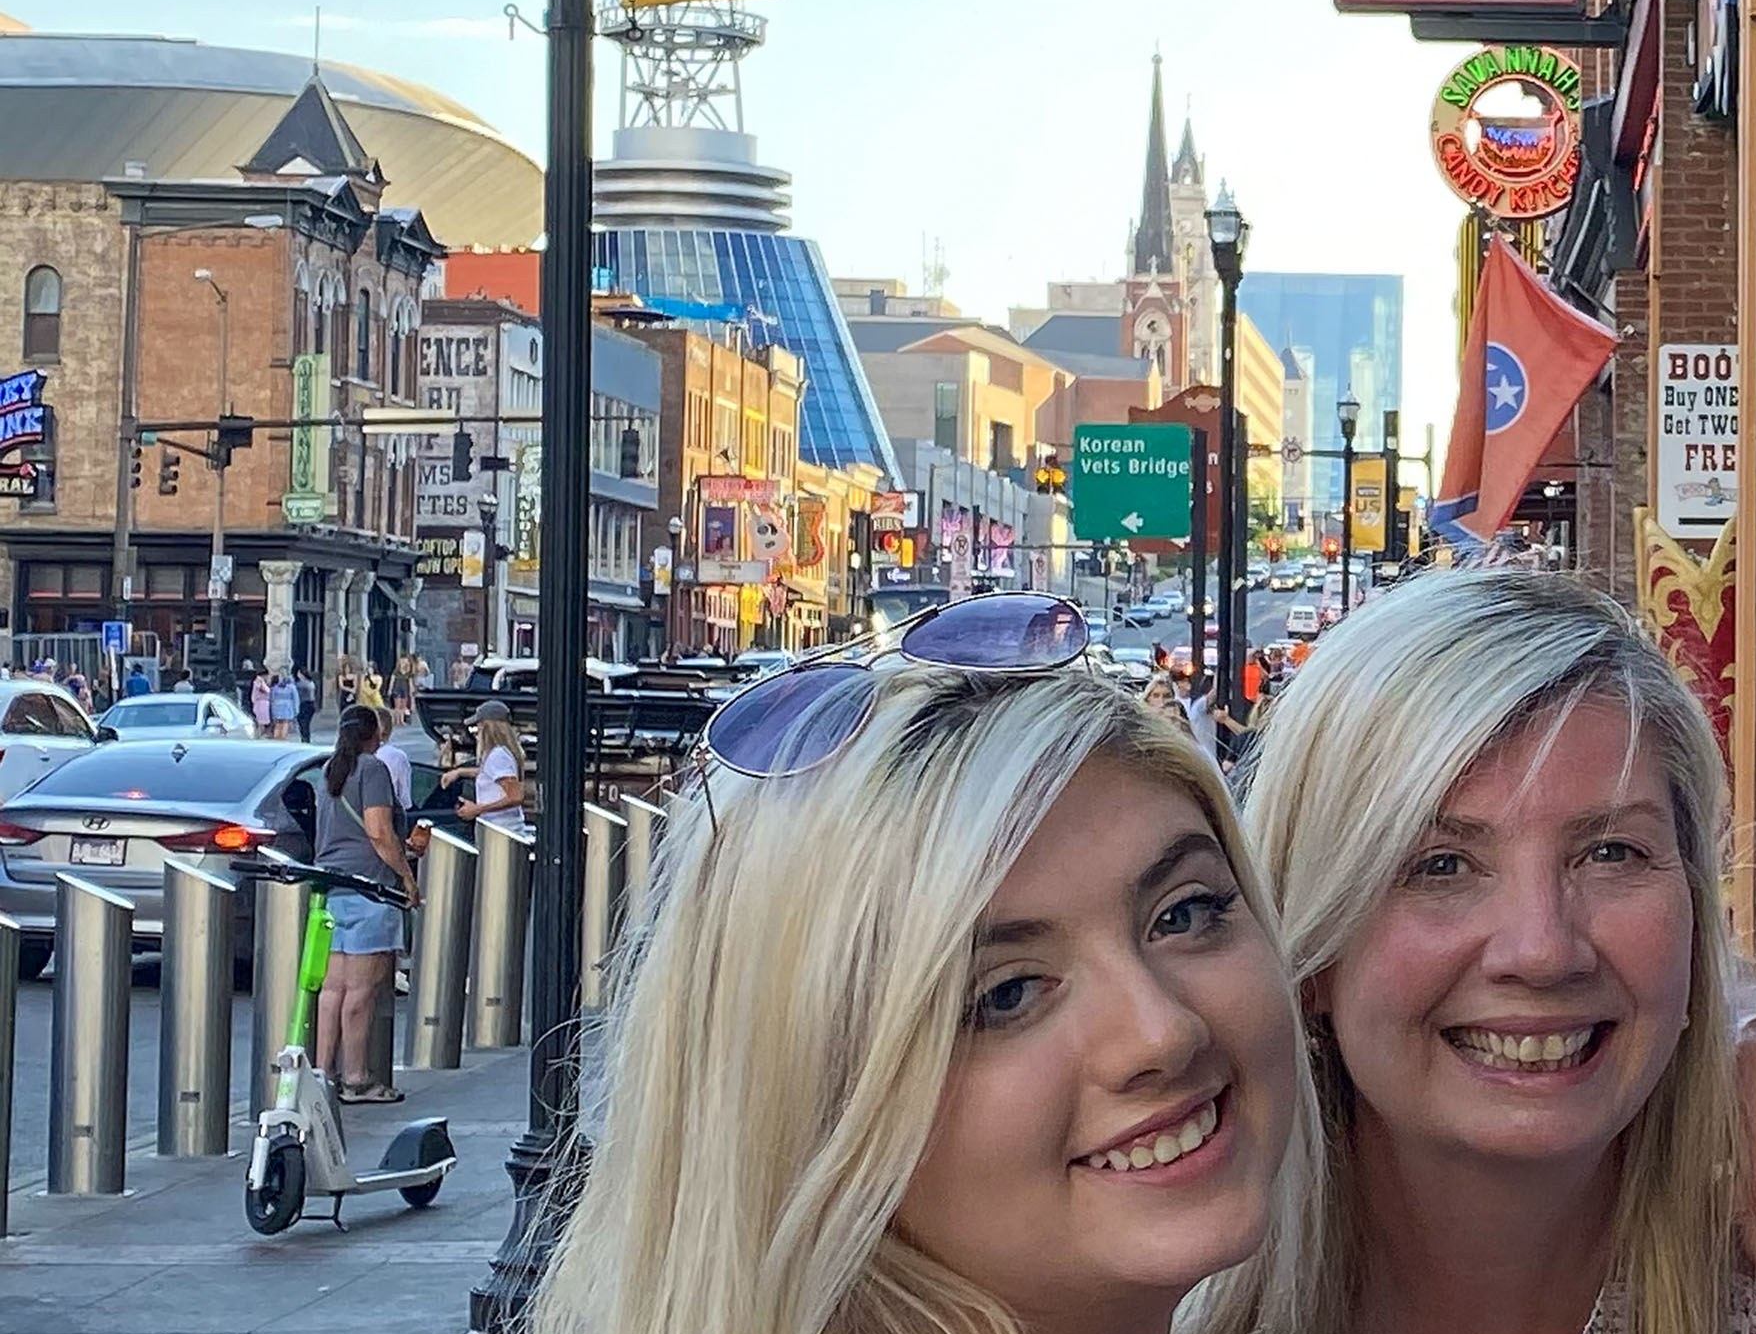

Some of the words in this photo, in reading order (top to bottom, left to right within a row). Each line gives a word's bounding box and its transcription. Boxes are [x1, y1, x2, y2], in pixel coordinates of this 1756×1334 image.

[1436, 133, 1505, 208] CANDY
[420, 337, 488, 376] ENCE
[1668, 352, 1739, 381] BOO
[1664, 385, 1697, 412] Buy
[1704, 385, 1738, 407] ONE
[1664, 413, 1691, 436] Get
[1698, 413, 1738, 436] TWO
[1079, 436, 1145, 454] Korean
[418, 464, 451, 485] MS
[1081, 458, 1121, 475] Vets
[1128, 458, 1190, 478] Bridge
